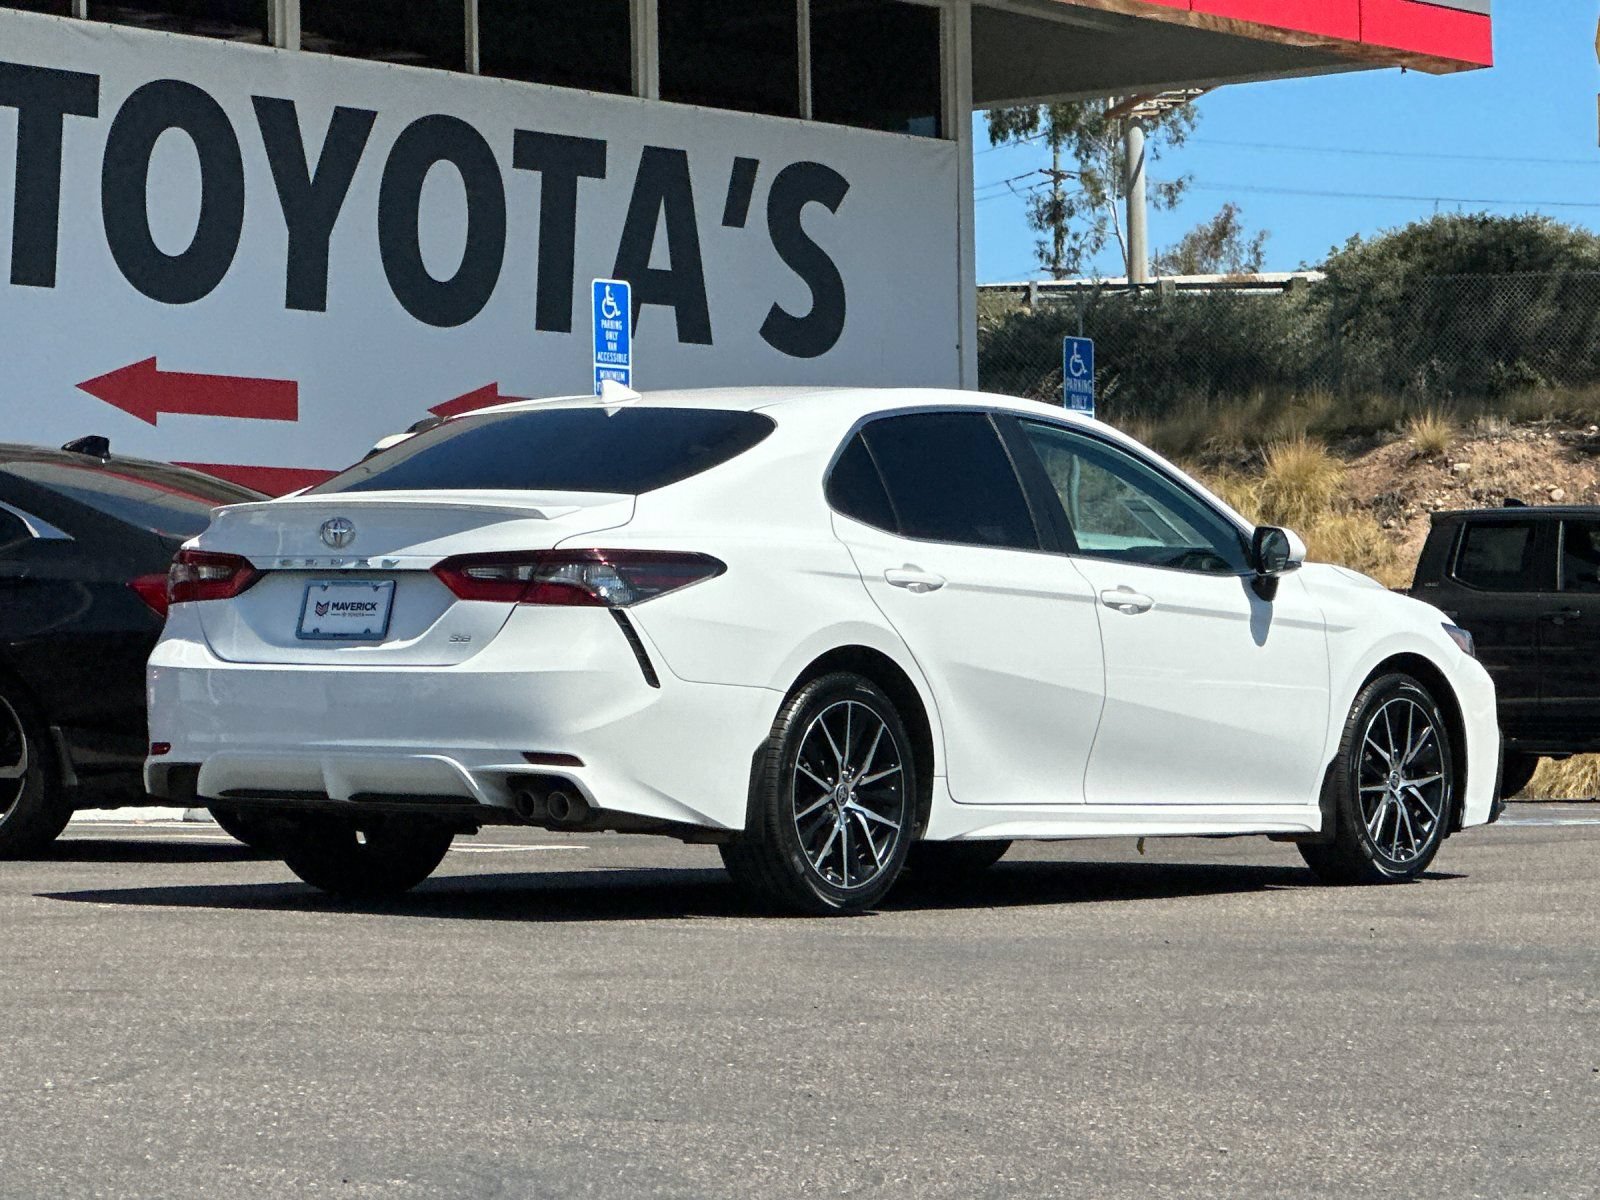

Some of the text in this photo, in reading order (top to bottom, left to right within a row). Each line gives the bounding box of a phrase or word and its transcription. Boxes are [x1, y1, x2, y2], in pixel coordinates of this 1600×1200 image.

[0, 62, 851, 358] TOYOTA'S
[601, 319, 623, 330] PARKING
[605, 330, 619, 341] ONLY
[607, 341, 618, 351] VAN
[597, 351, 628, 364] ACCESSIBLE
[1066, 376, 1092, 394] PARKING
[1071, 393, 1088, 409] ONLY
[331, 601, 378, 611] MAVERICK
